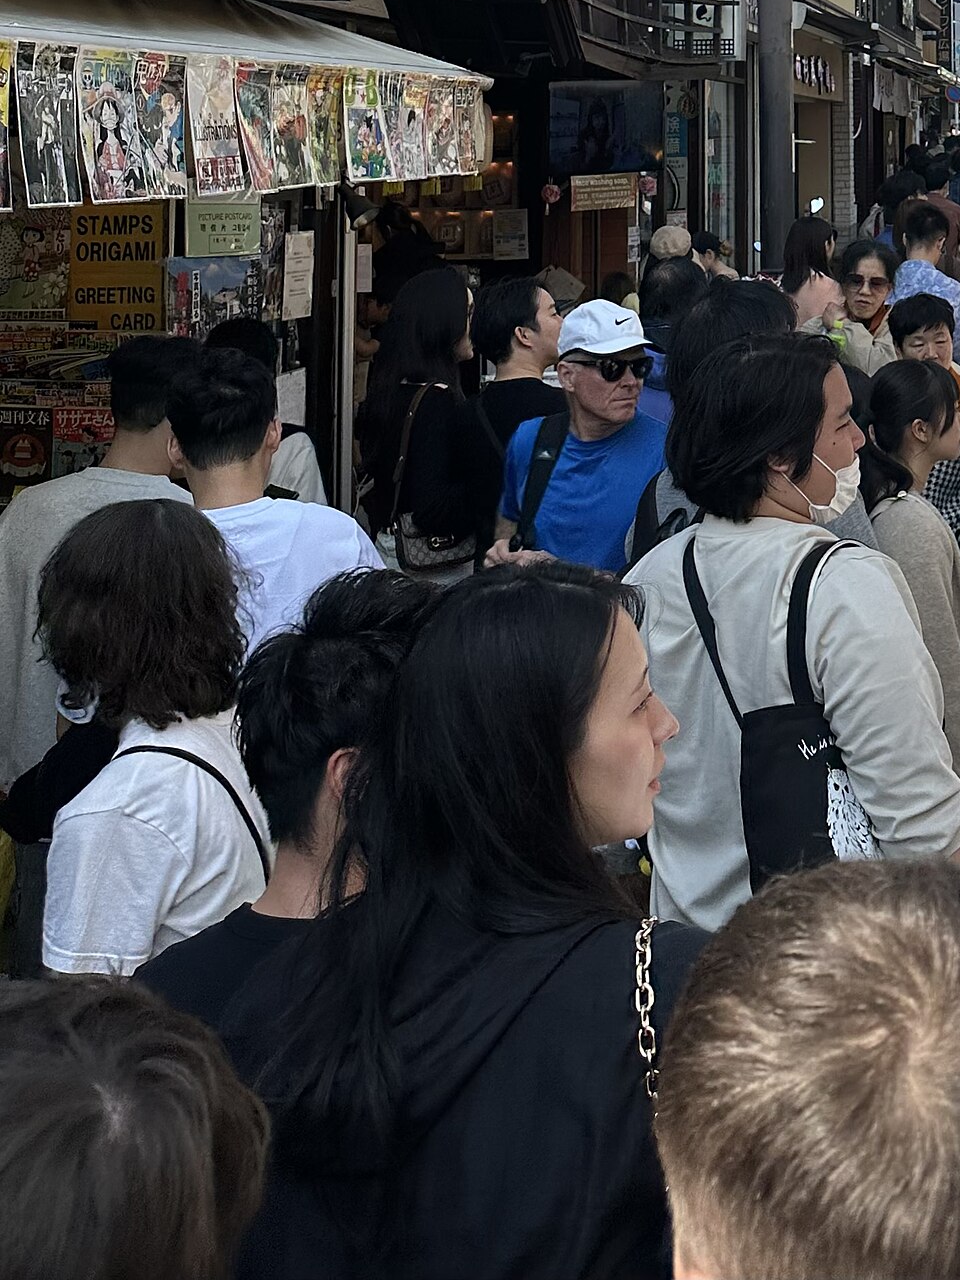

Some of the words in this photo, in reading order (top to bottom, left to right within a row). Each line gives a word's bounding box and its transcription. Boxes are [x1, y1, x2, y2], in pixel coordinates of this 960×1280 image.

[77, 215, 153, 236] STAMPS
[76, 241, 156, 261] ORIGAMI
[75, 287, 155, 304] GREETING
[110, 313, 155, 331] CARD
[0, 410, 50, 425] 週刊文春
[56, 410, 115, 427] サザエさん
